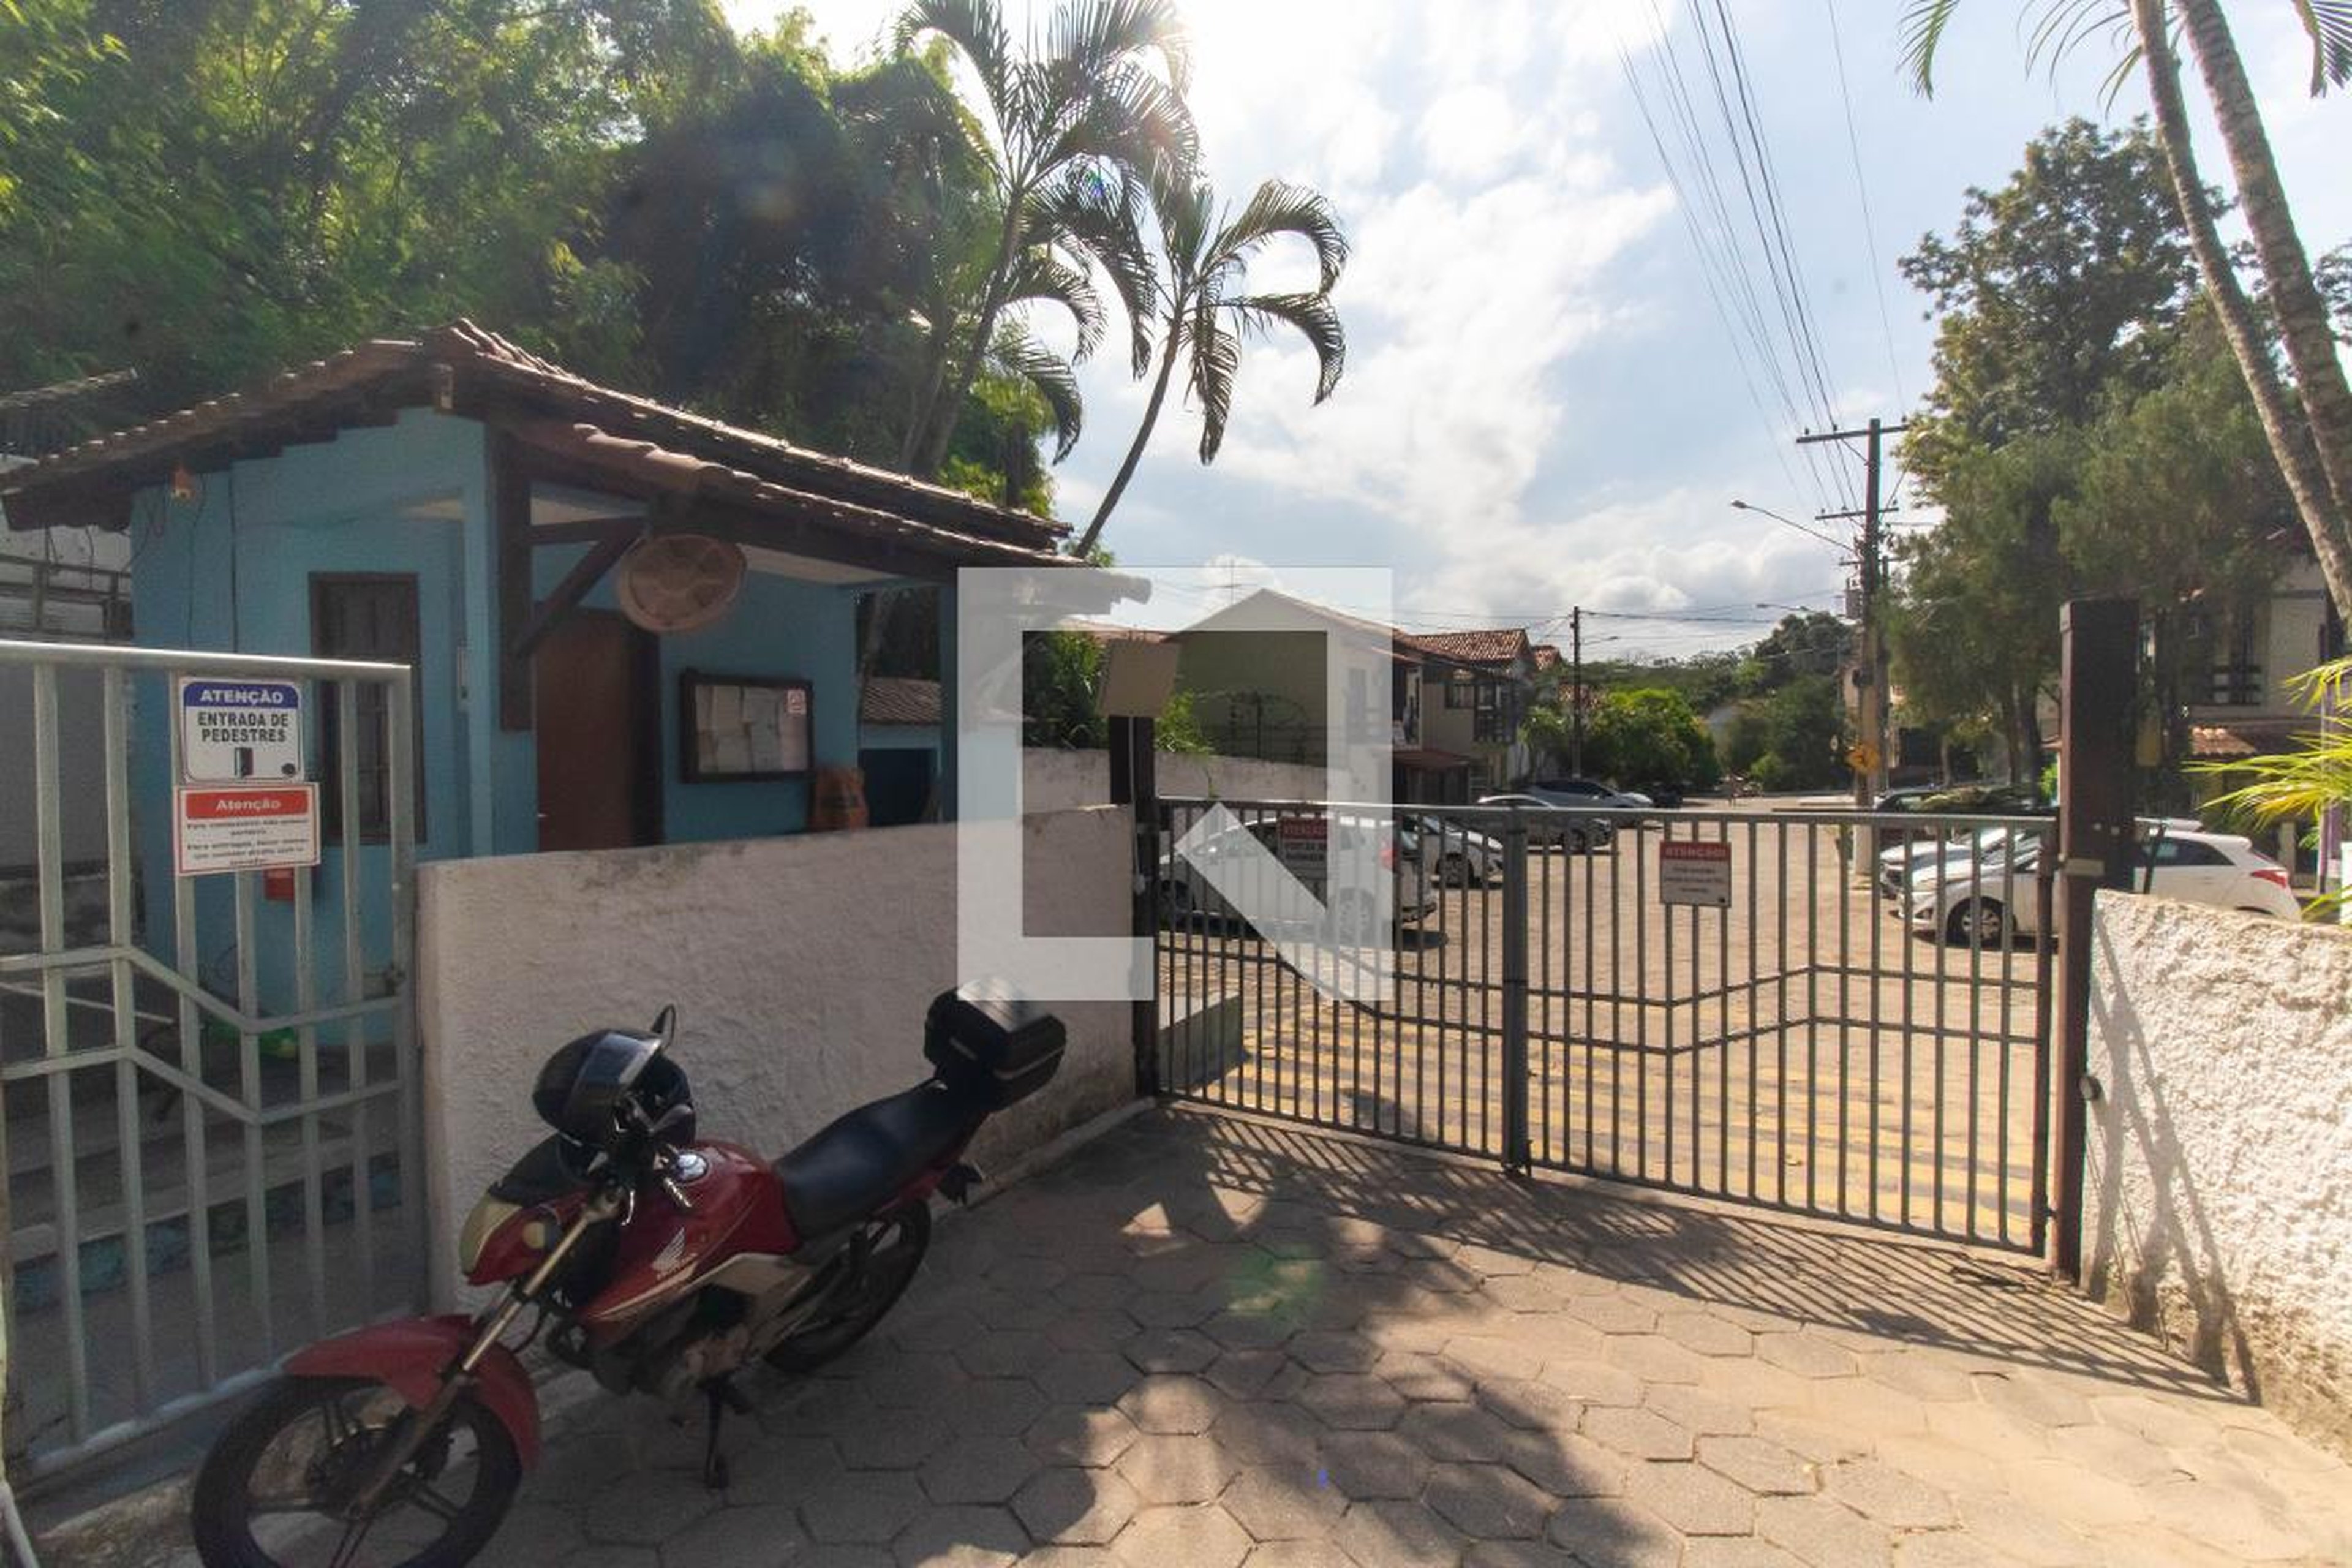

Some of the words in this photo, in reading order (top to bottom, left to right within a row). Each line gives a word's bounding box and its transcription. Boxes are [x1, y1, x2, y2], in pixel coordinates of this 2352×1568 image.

[200, 689, 284, 704] ATENÇÃO
[198, 712, 266, 727] ENTRADA
[271, 714, 289, 727] DE
[202, 729, 287, 742] PEDESTRES
[216, 799, 281, 812] Atenção
